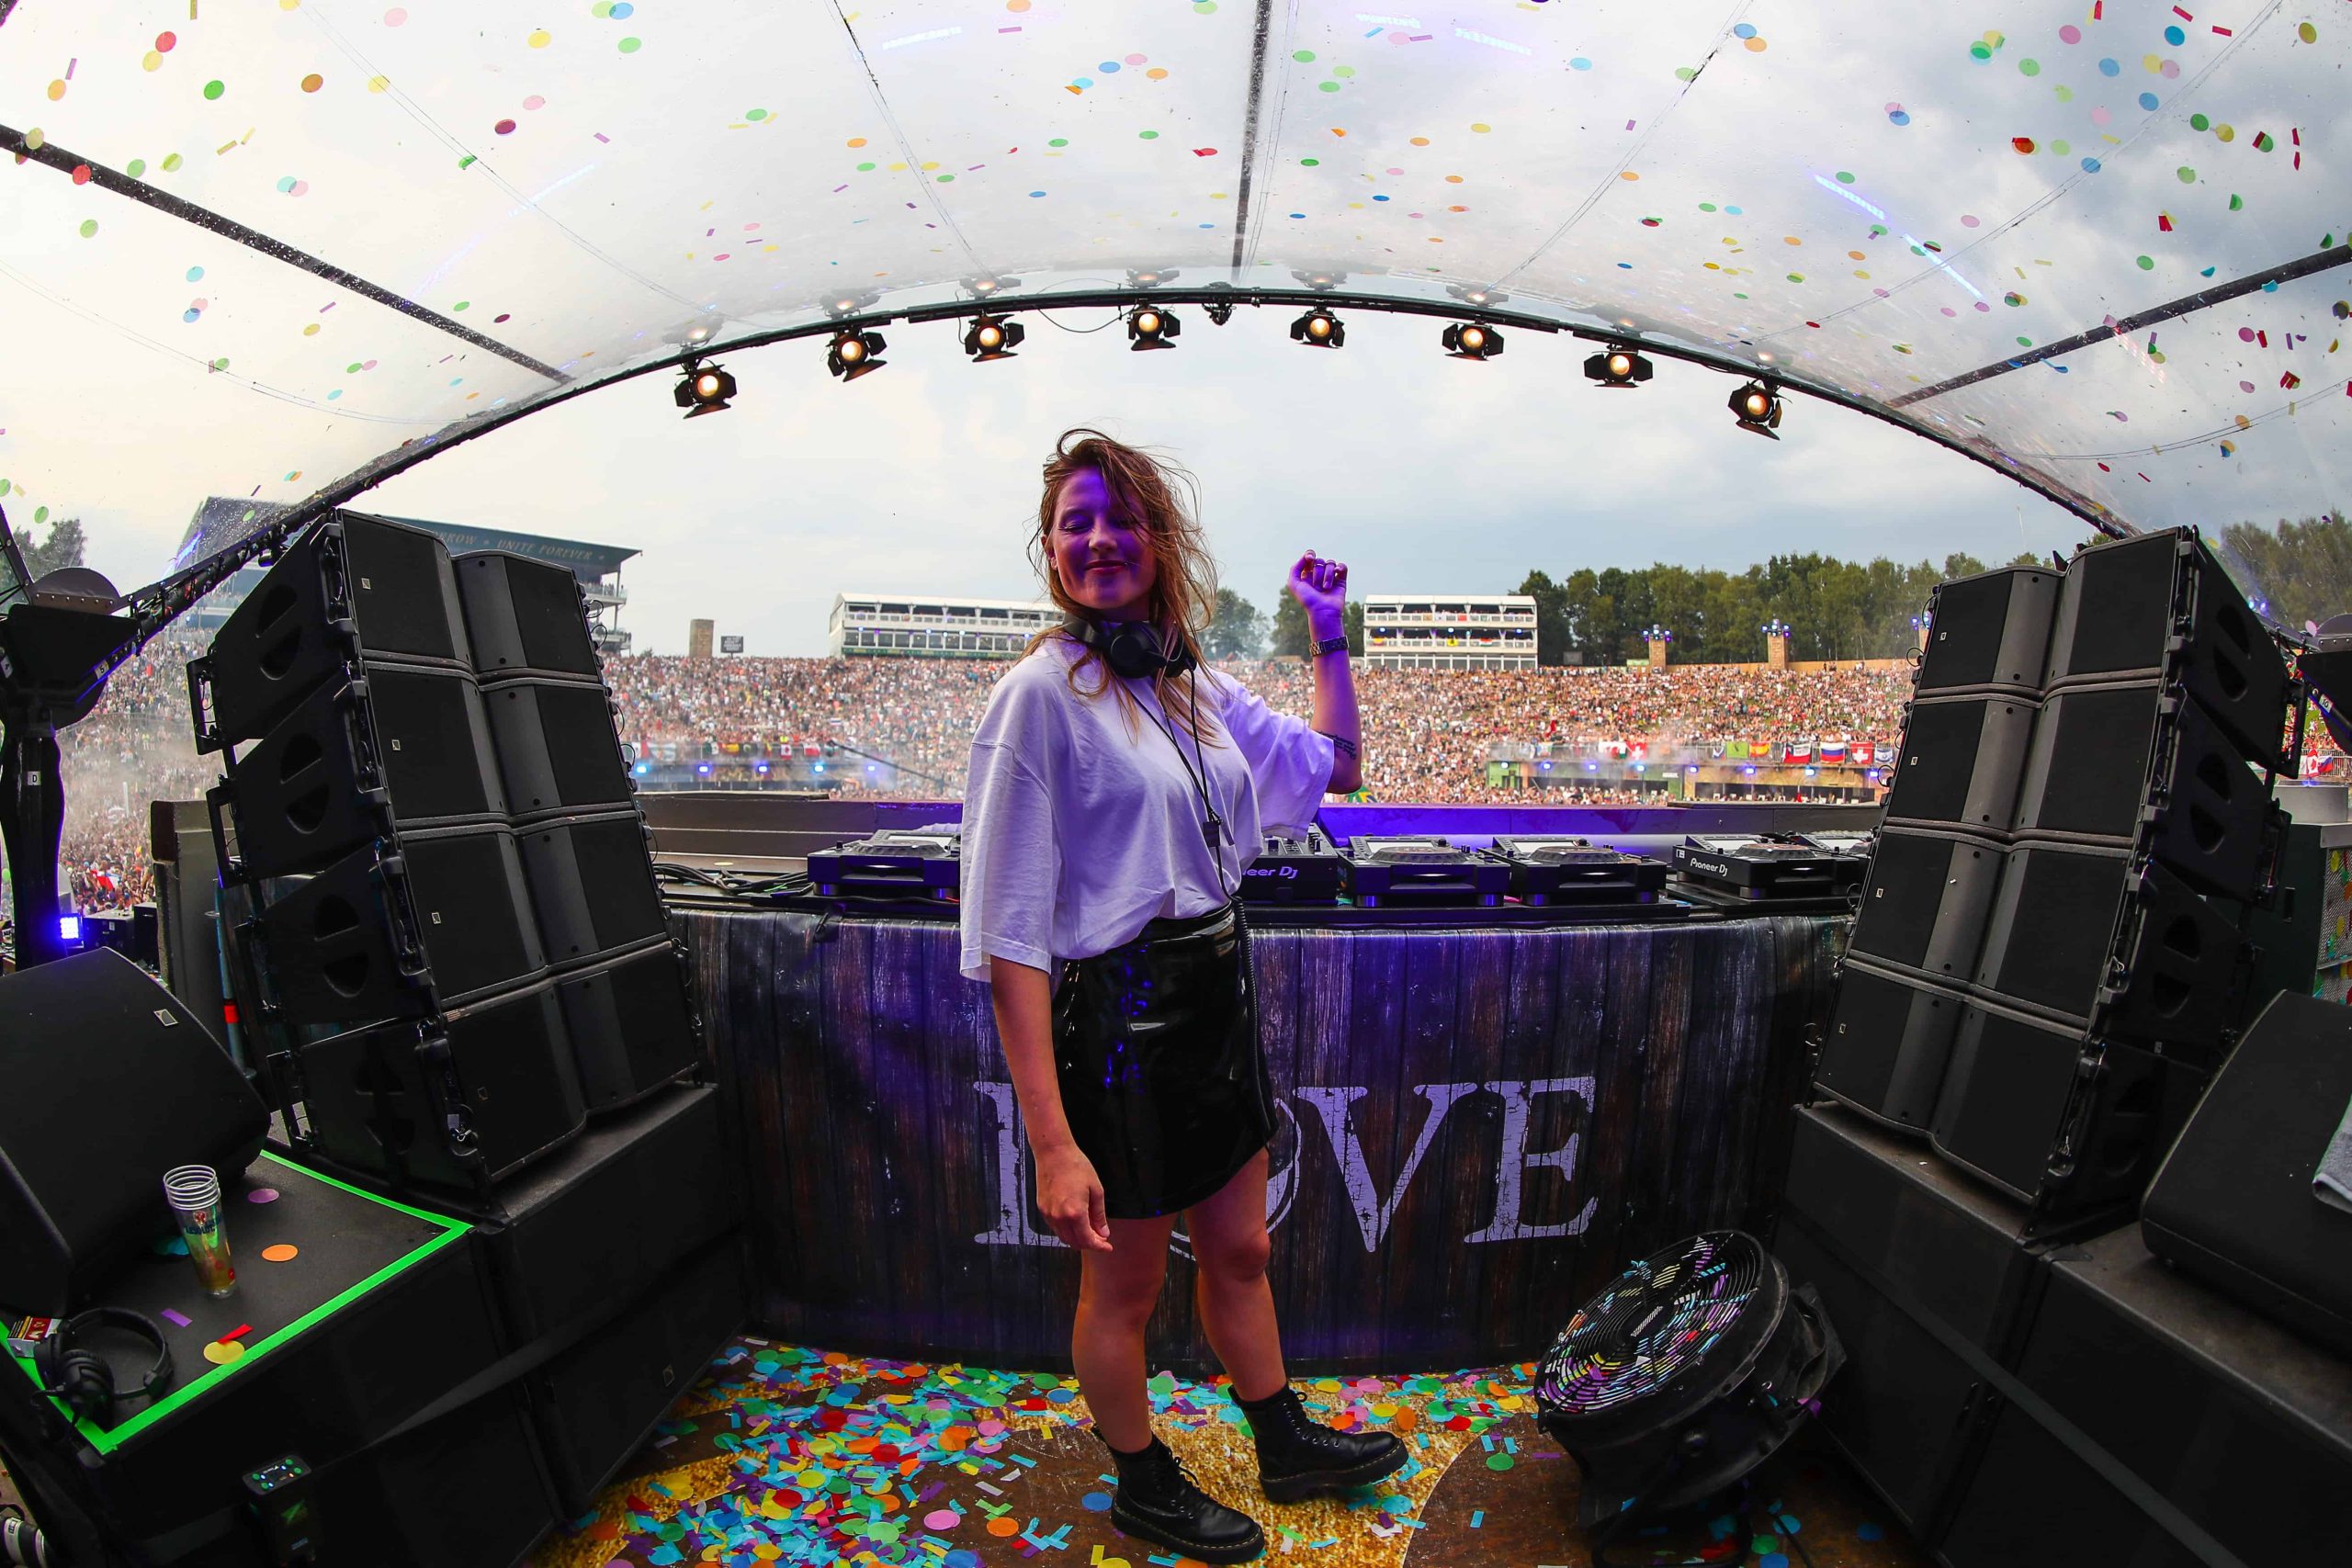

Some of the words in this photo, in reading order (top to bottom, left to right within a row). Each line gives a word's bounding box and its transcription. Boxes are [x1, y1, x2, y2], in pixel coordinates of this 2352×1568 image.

[496, 539, 536, 553] UNITE
[538, 544, 594, 560] FOREVER
[1690, 857, 1718, 872] Pioneer
[973, 1076, 1599, 1261] LVE
